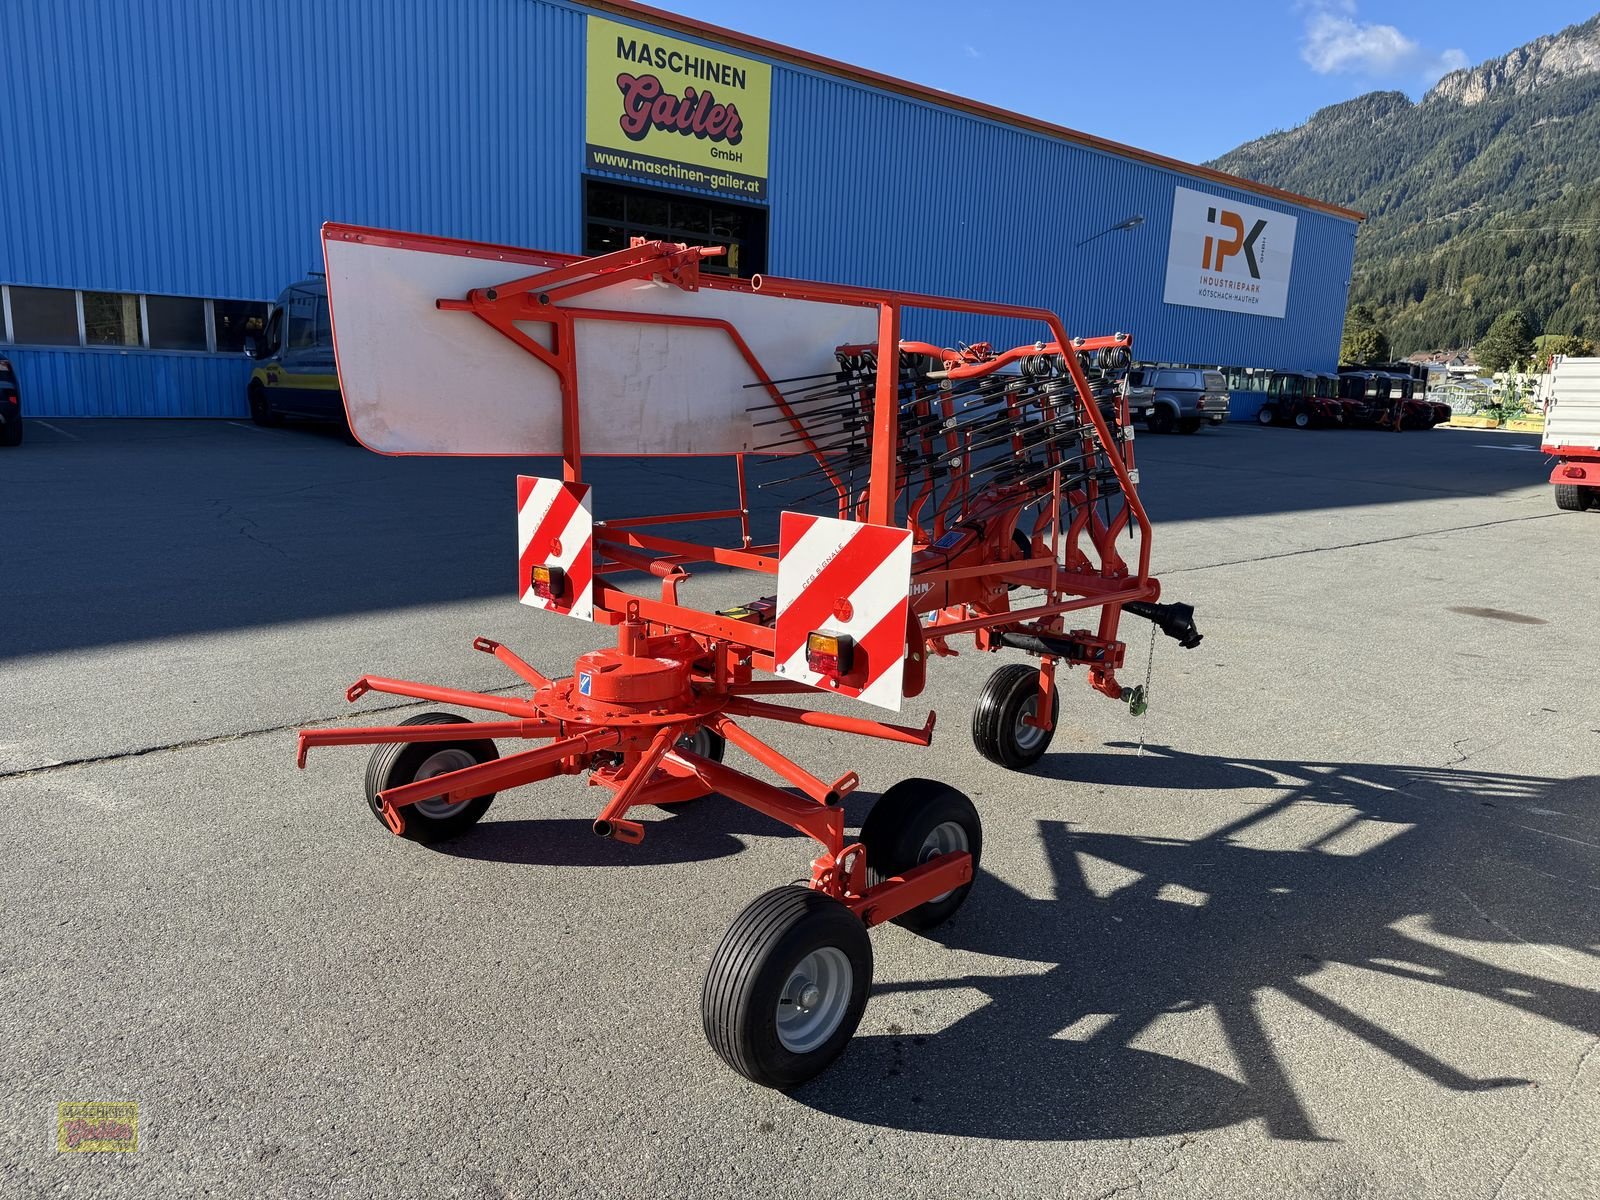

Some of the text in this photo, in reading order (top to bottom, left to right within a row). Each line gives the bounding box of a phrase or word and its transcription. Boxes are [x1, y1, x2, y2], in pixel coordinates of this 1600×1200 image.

[616, 36, 746, 90] MASCHINEN
[616, 72, 744, 146] Gailer
[710, 147, 743, 163] GmbH
[593, 151, 760, 193] www.maschinen-gailer.at
[1199, 276, 1261, 293] INDUSTRIEPARK
[801, 574, 816, 590] CFG
